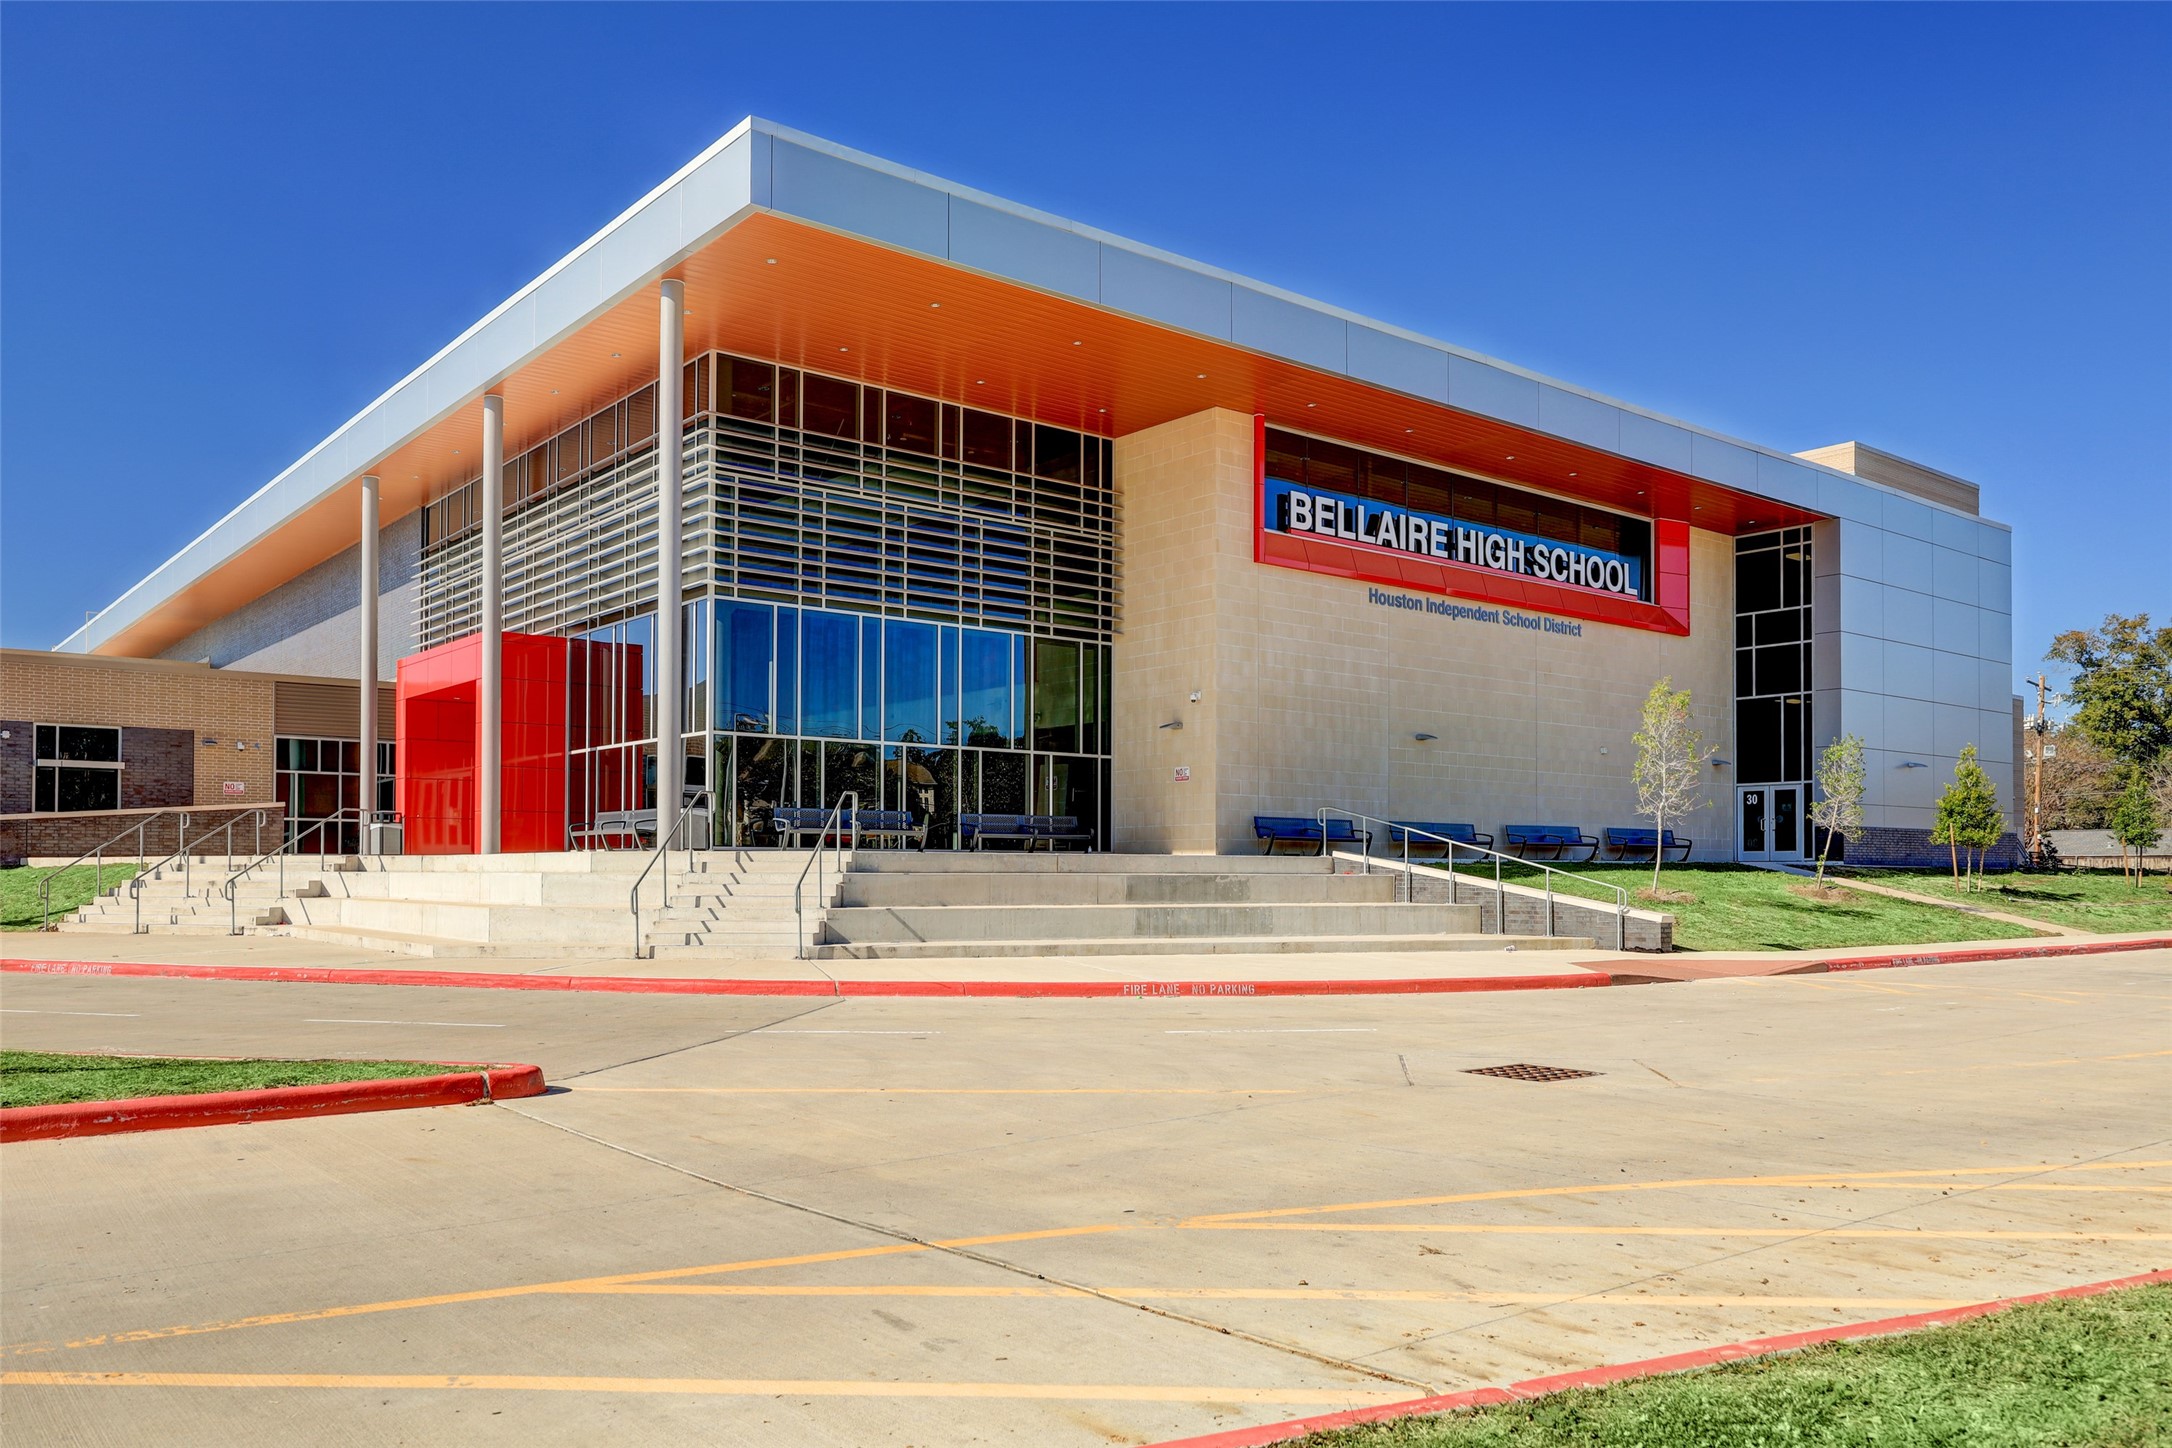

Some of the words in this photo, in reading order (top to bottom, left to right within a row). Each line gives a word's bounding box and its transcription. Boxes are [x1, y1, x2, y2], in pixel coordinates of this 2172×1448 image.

[1290, 490, 1449, 558] BELLAIRE
[1457, 526, 1525, 574] HIGH
[1533, 543, 1638, 596] SCHOOL
[1368, 587, 1423, 611] Houston
[1426, 597, 1500, 624] Independent
[1502, 604, 1541, 631] School
[1543, 616, 1583, 637] District
[1746, 794, 1758, 805] 30
[1123, 984, 1148, 995] FIRE
[1152, 984, 1180, 995] LANE
[1191, 984, 1206, 995] NO
[1209, 984, 1256, 995] PARKING
